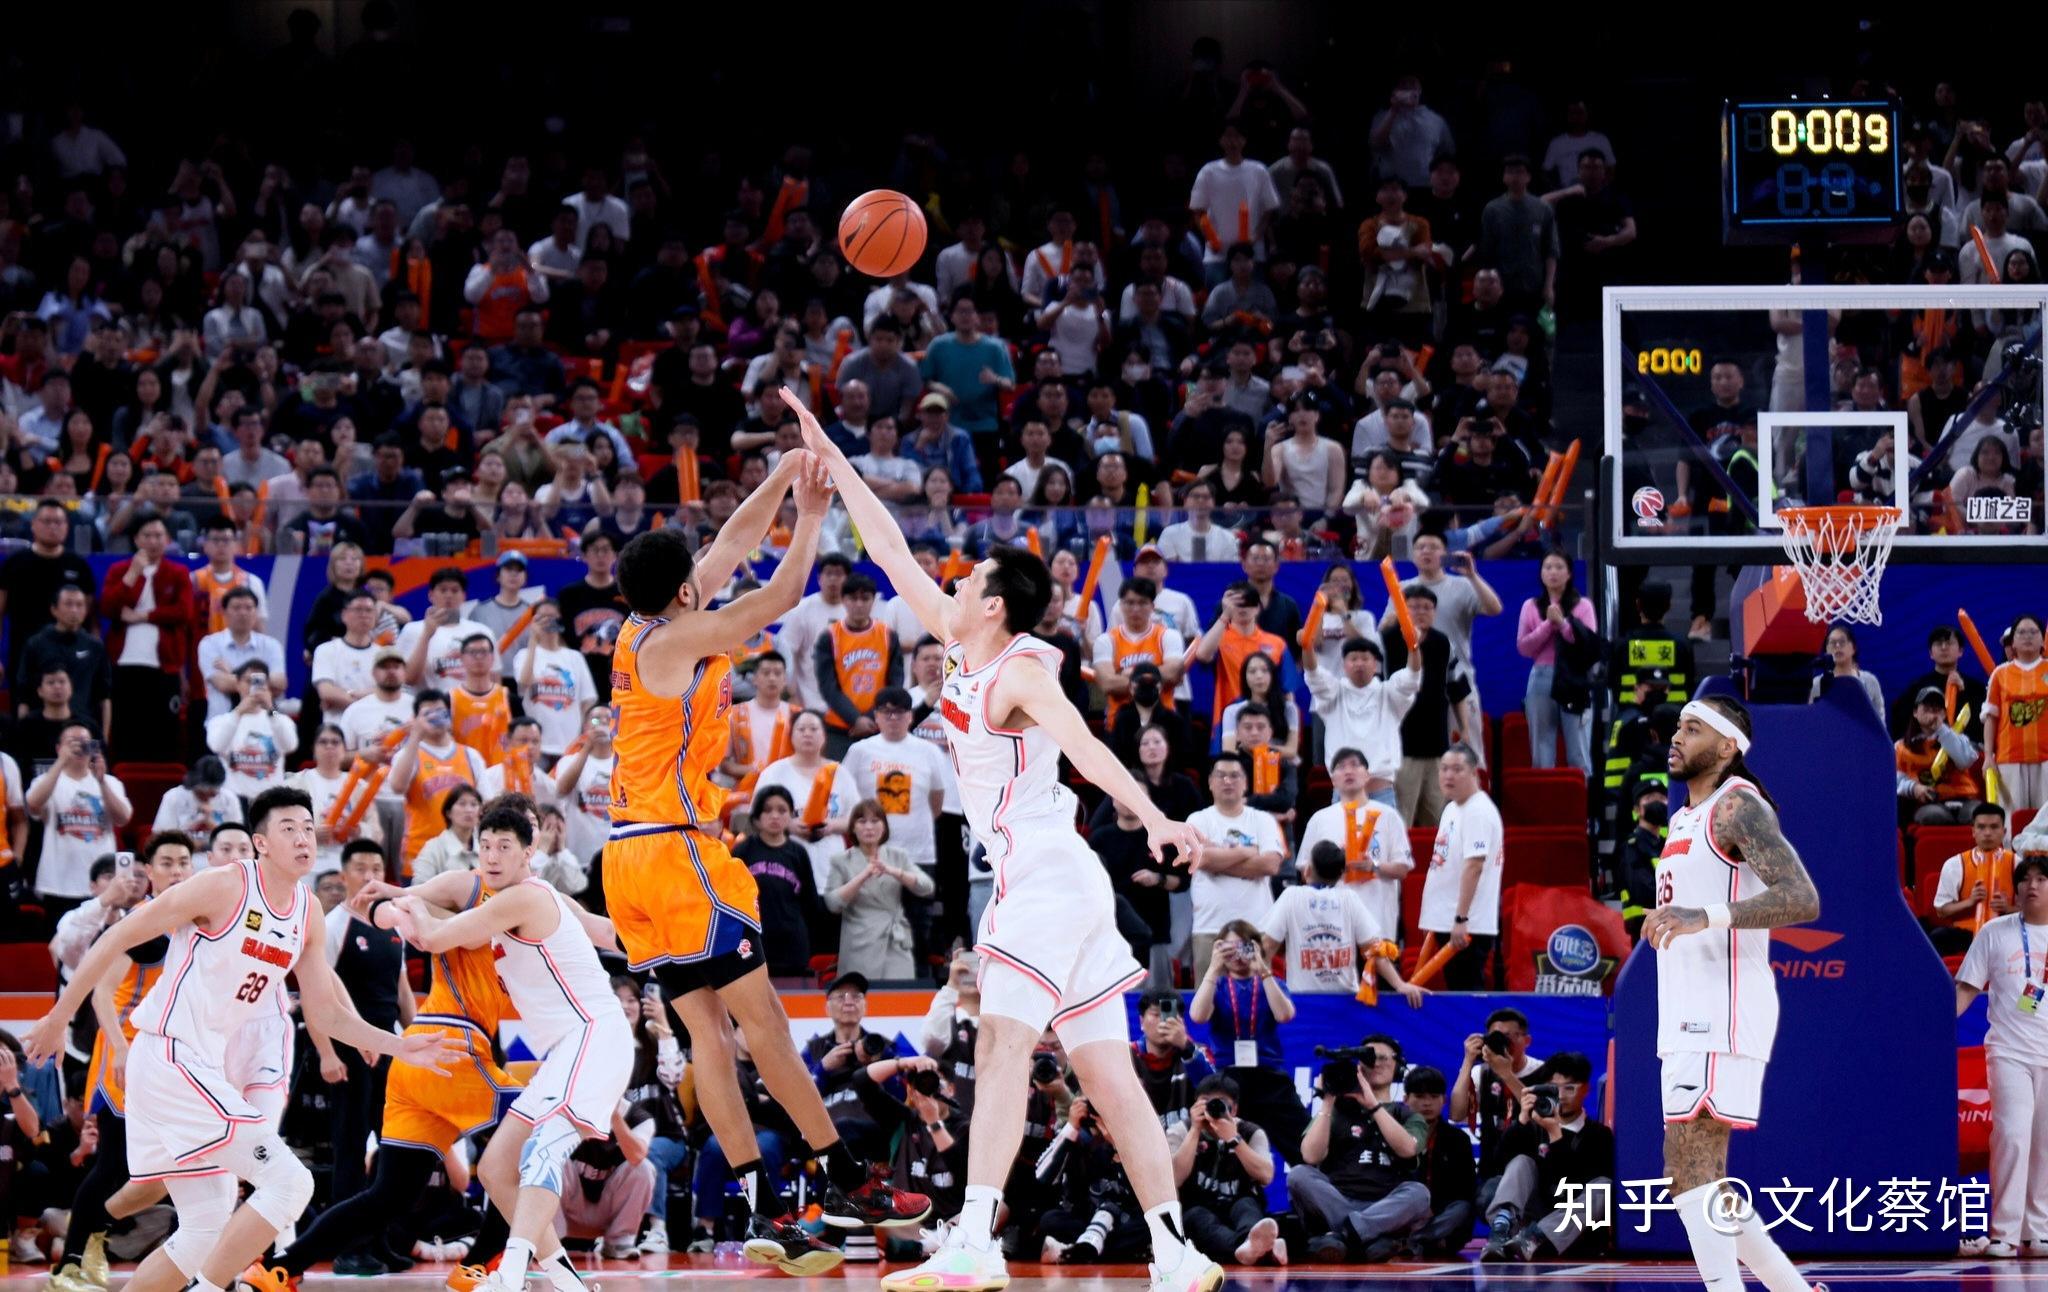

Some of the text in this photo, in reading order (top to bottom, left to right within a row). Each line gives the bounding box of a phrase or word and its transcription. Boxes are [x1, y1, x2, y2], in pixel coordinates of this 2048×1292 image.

[1967, 496, 2031, 521] 以城之名
[1631, 644, 1673, 661] 保安
[1658, 870, 1673, 906] 26
[1769, 960, 1846, 977] NING
[235, 972, 269, 1004] 28
